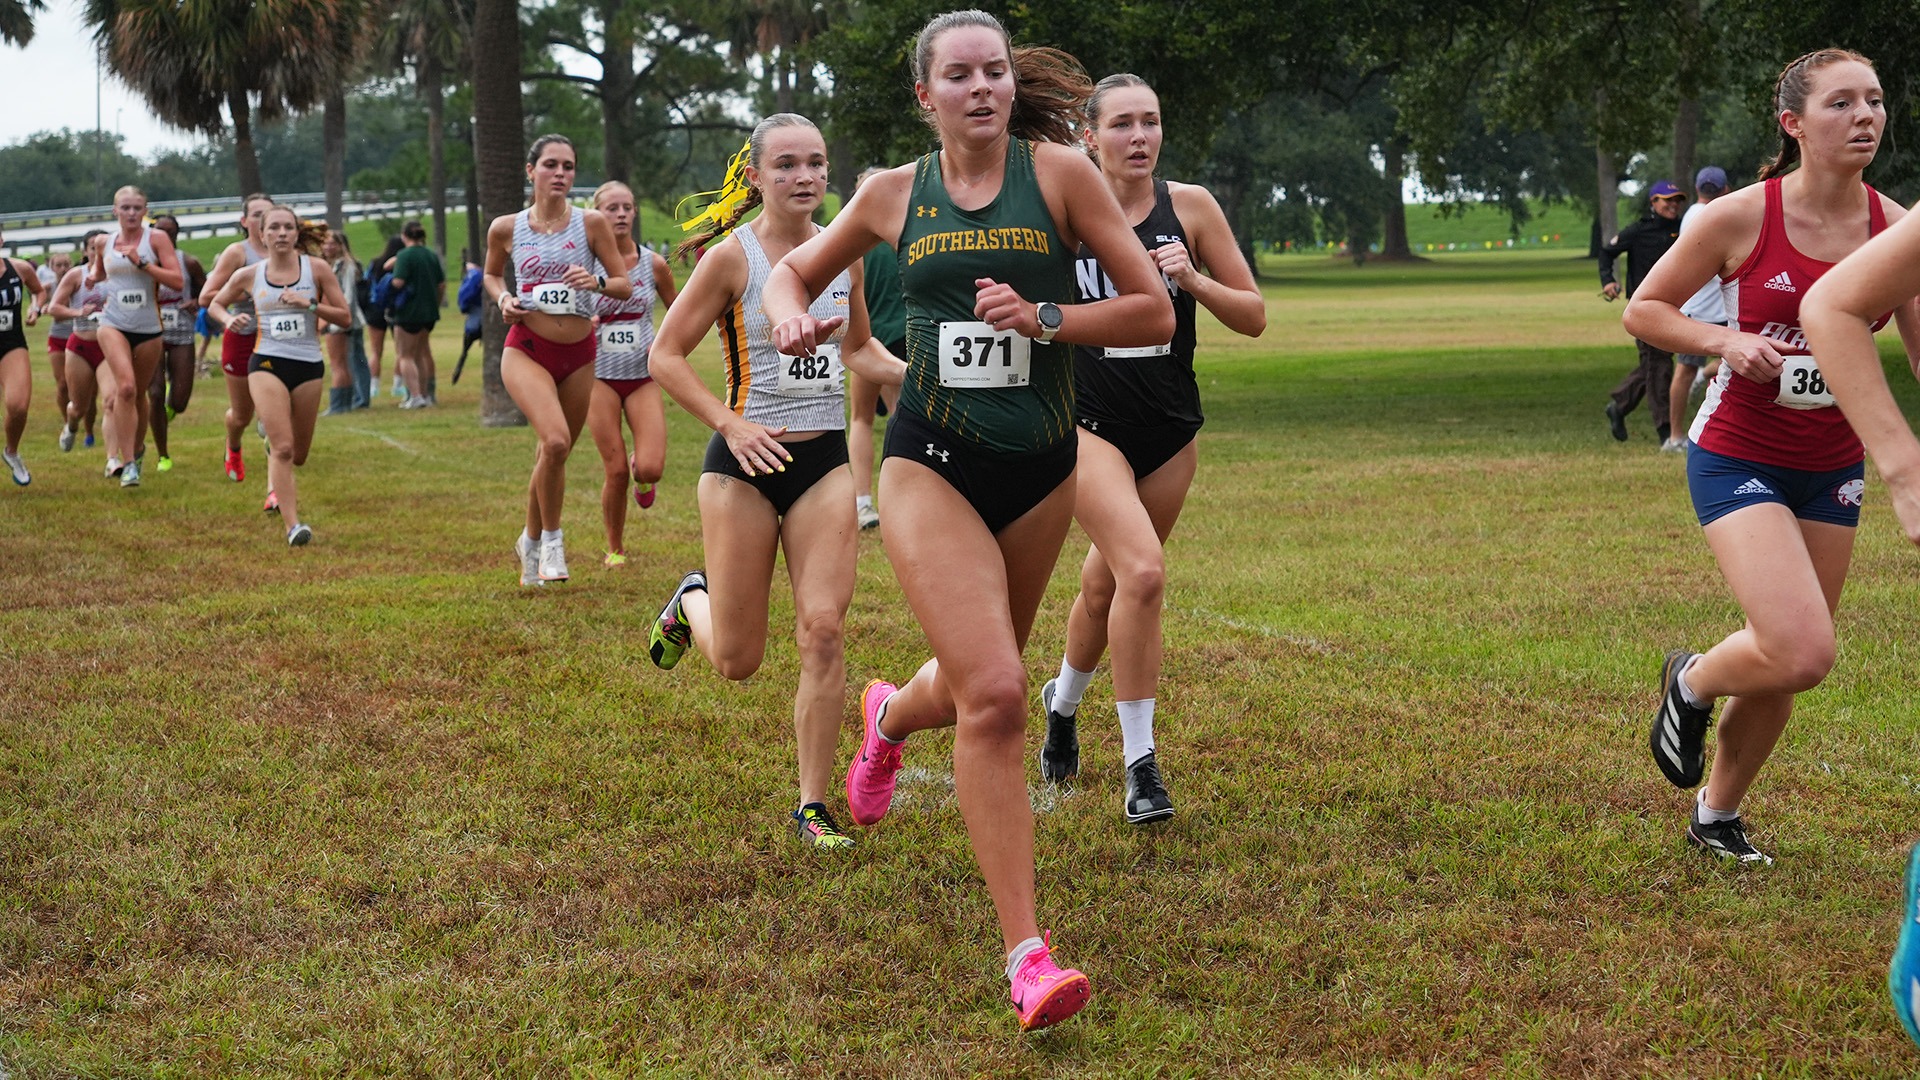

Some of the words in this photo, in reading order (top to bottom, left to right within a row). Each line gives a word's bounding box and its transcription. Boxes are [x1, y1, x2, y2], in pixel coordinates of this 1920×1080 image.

[907, 227, 1050, 266] SOUTHEASTERN
[1764, 282, 1796, 293] adidas
[540, 290, 569, 304] 432
[276, 320, 298, 331] 481
[608, 331, 634, 344] 435
[953, 336, 1011, 367] 371
[788, 355, 830, 380] 482
[1792, 368, 1832, 395] 38
[1733, 486, 1774, 495] adidas
